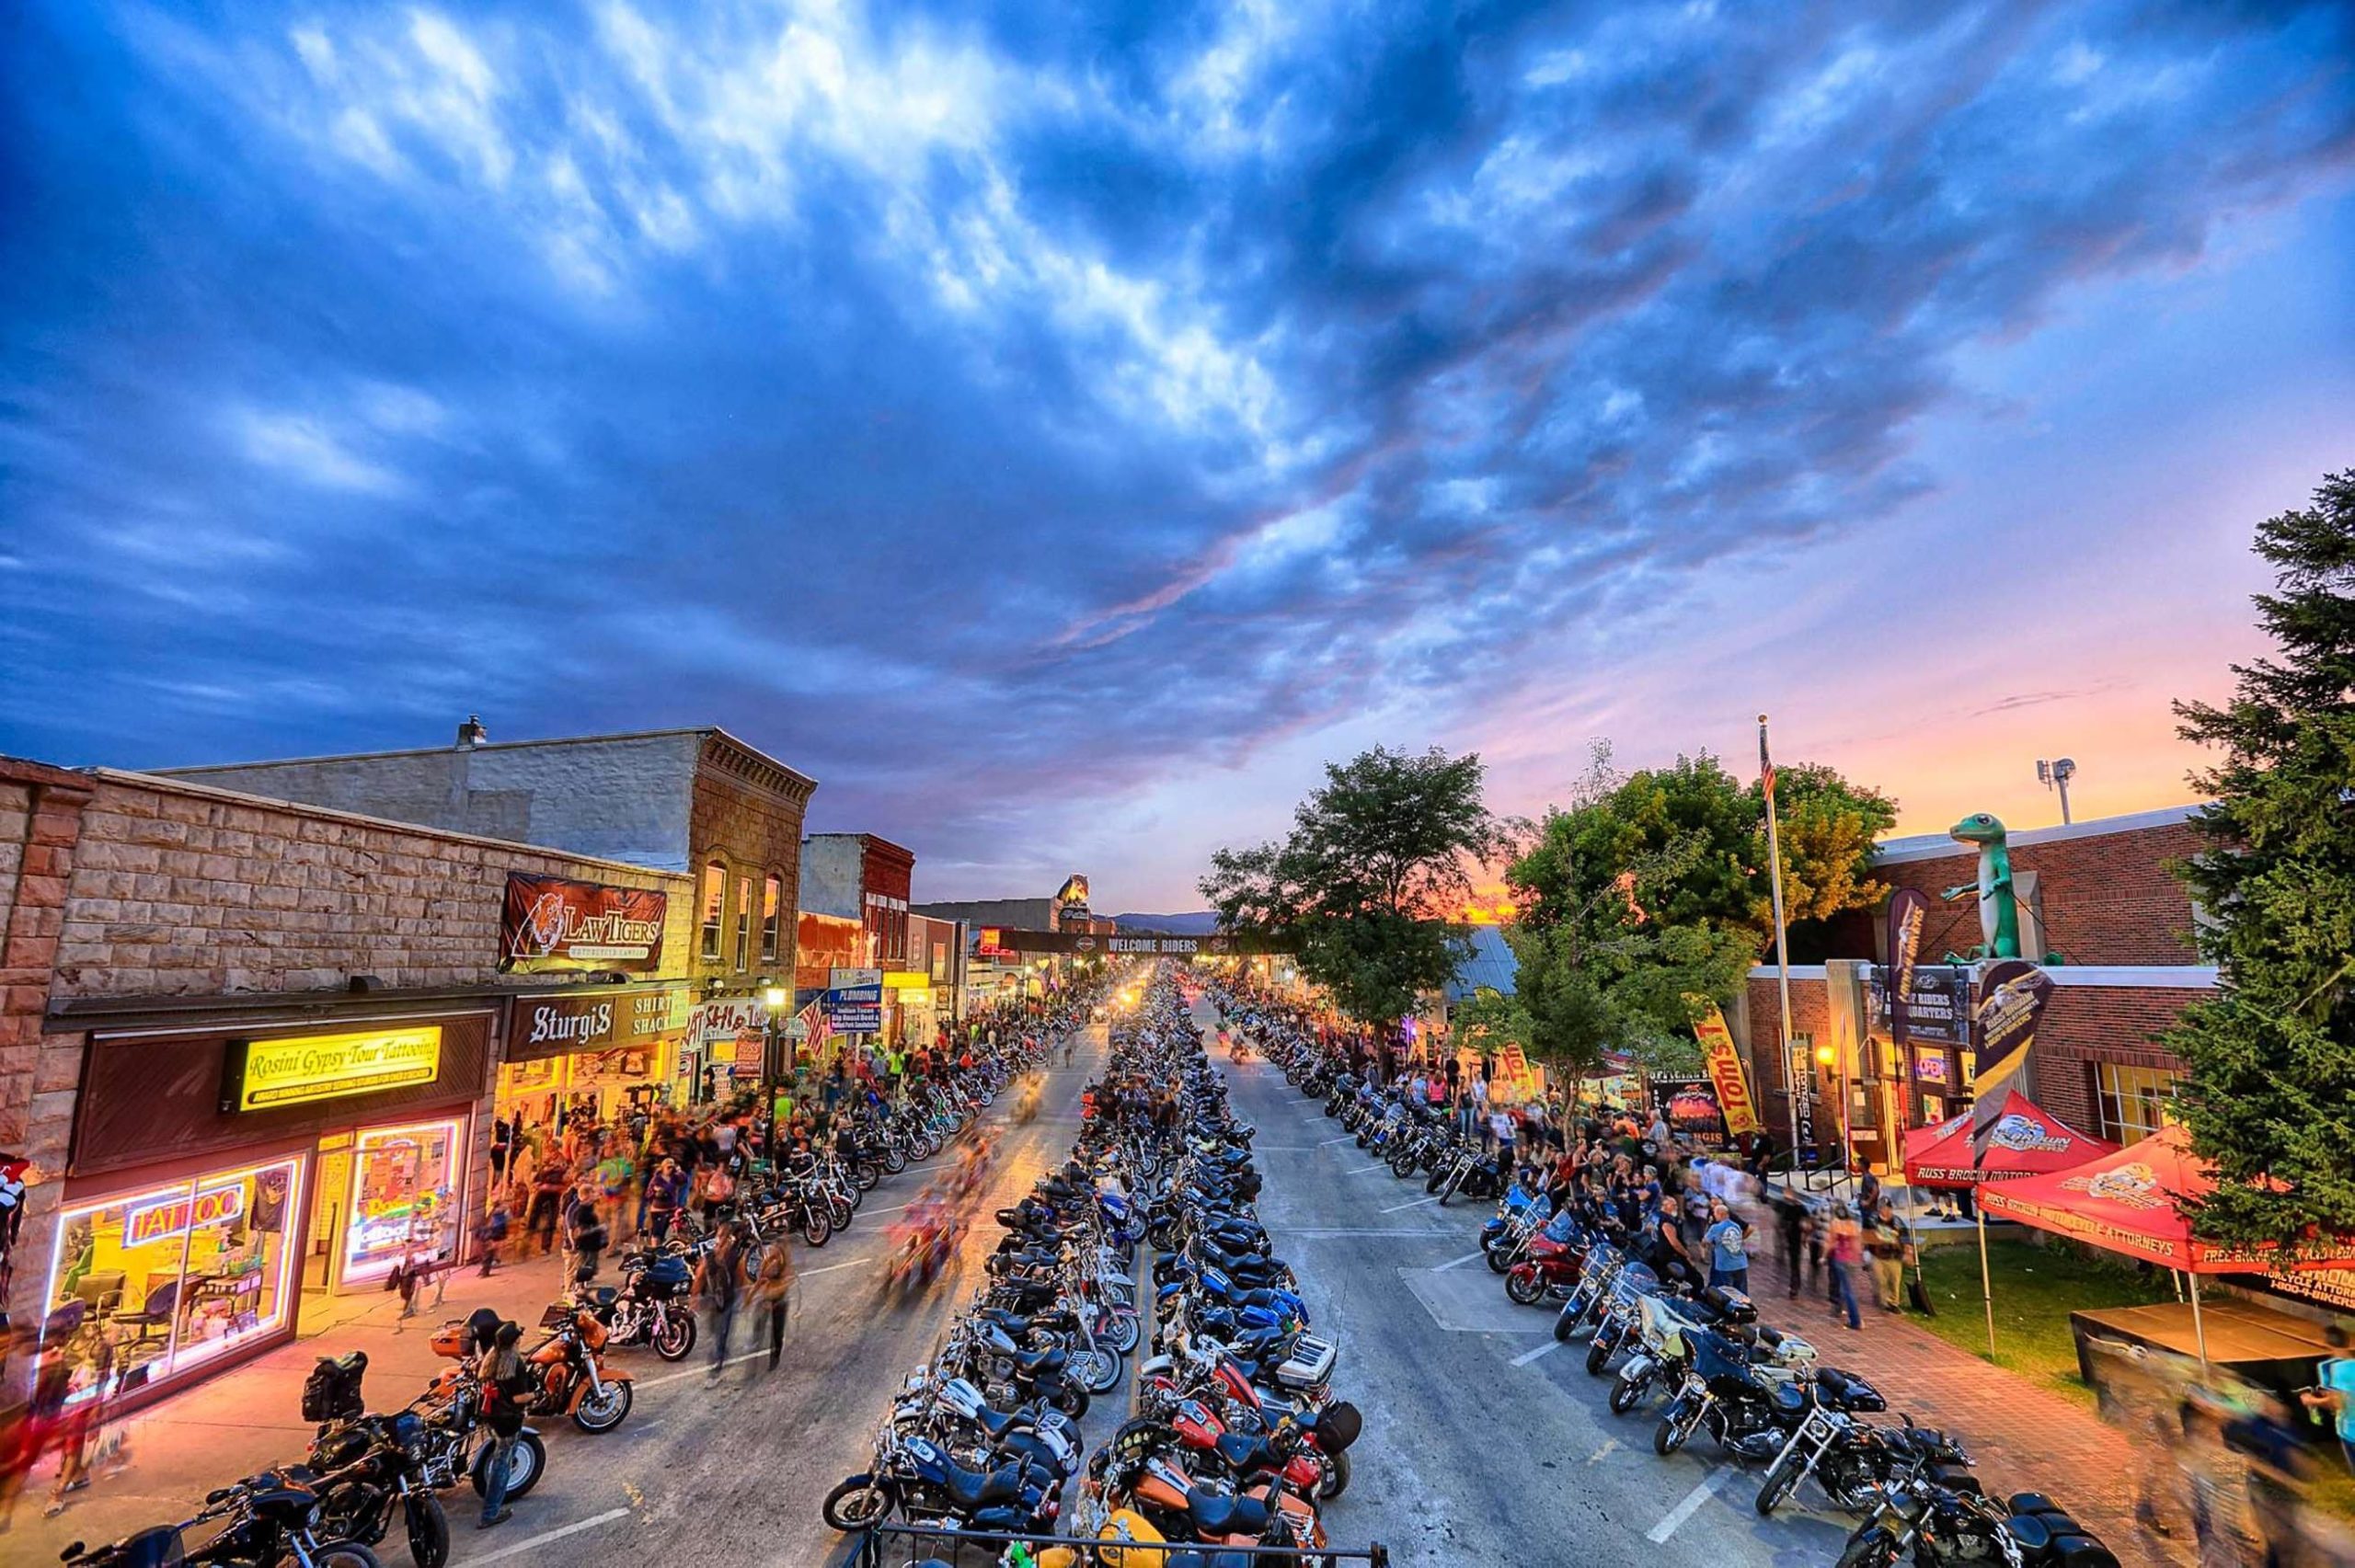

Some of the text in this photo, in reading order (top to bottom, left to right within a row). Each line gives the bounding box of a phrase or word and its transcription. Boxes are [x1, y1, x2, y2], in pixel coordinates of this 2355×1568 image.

[1109, 938, 1156, 952] WELCOME
[1162, 939, 1198, 953] RIDERS
[839, 990, 878, 1001] PLUMBING
[1918, 993, 1949, 1005] RIDERS
[635, 996, 672, 1014] SHIRT
[633, 1016, 671, 1035] SHACK
[250, 1038, 438, 1079] Rosini Gypsy Tour Tattooing
[1917, 1167, 1946, 1180] RUSS
[1984, 1192, 2005, 1207] RUSS
[2106, 1229, 2175, 1256] ATTORNEYS
